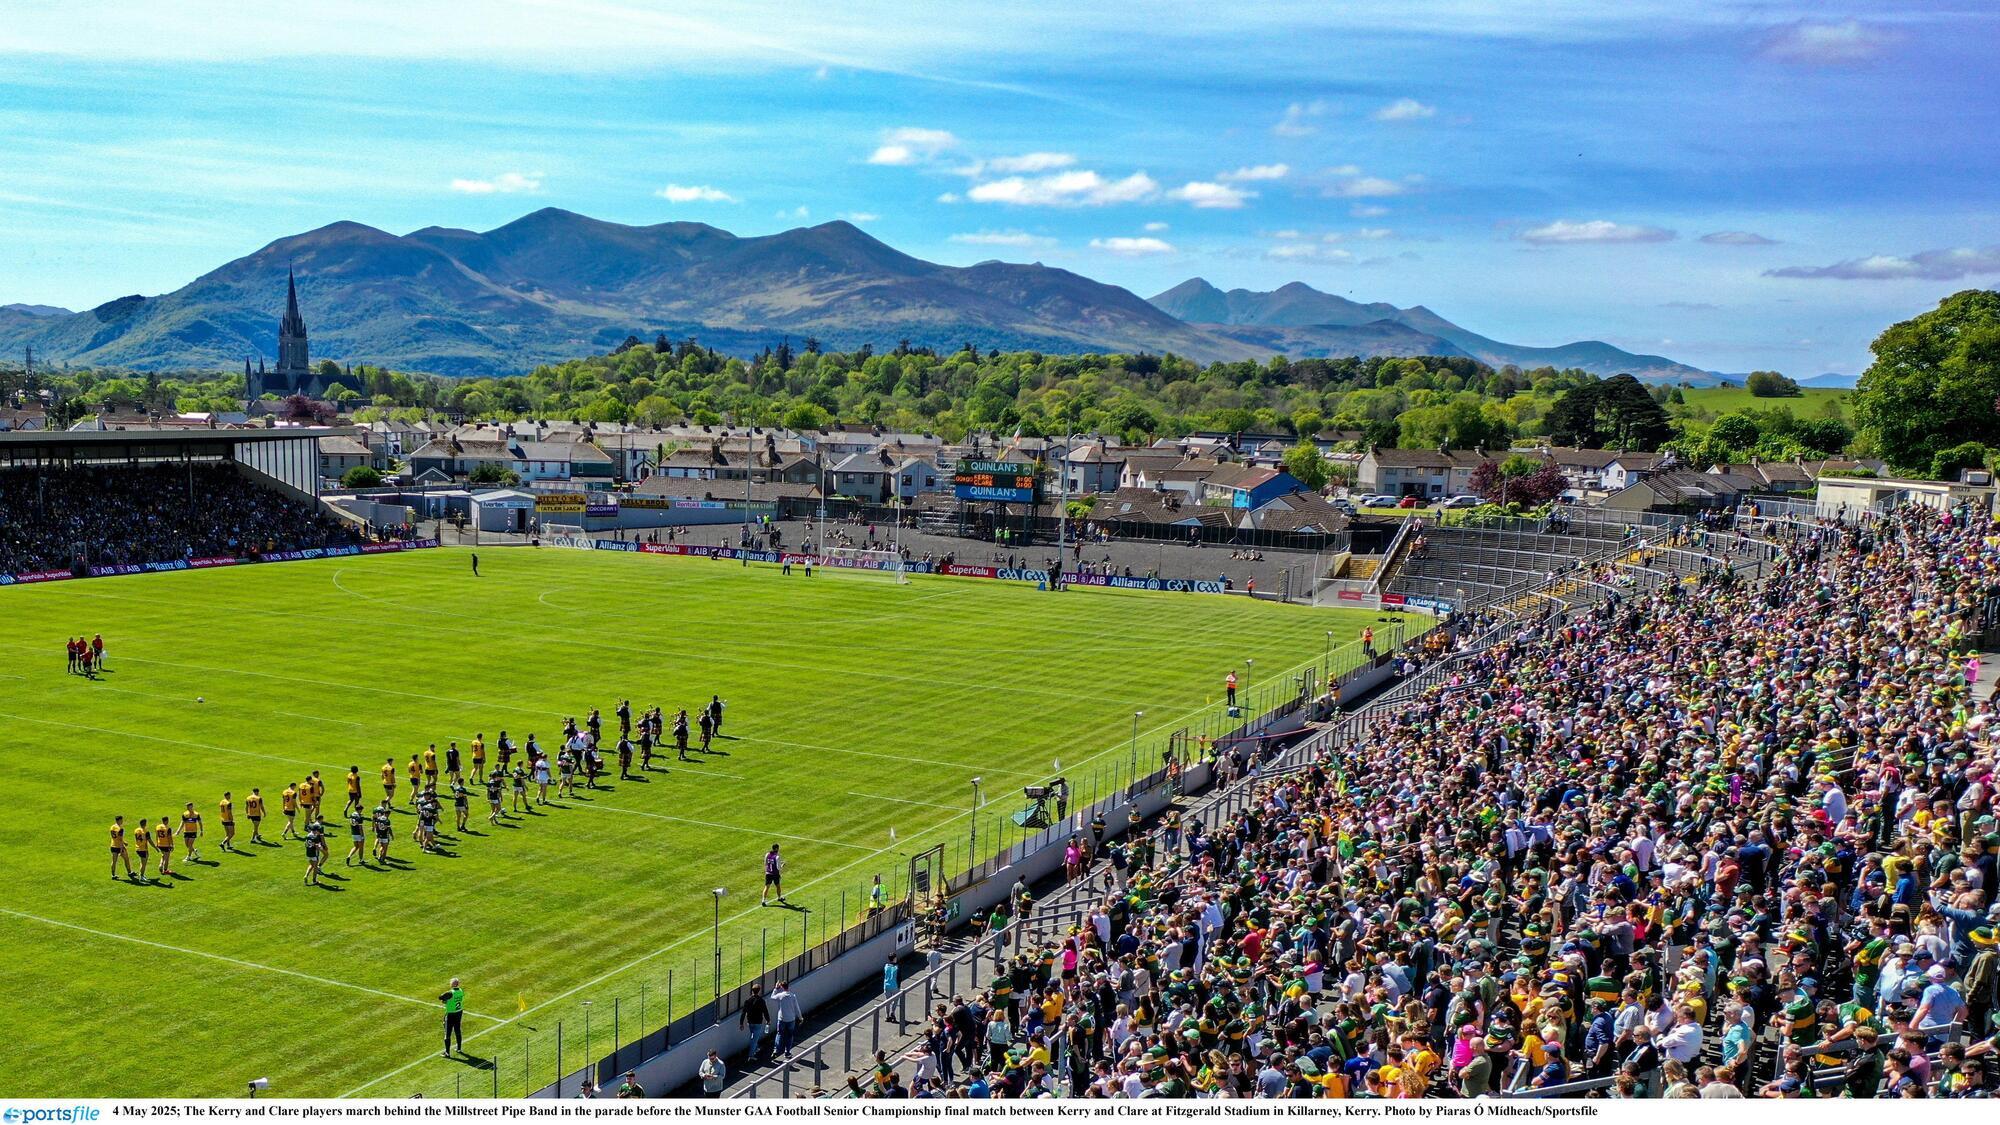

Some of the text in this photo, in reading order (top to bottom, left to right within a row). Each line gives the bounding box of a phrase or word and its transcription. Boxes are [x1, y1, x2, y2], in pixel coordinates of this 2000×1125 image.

[971, 462, 1018, 472] QUINLAN'S
[970, 487, 1017, 497] QUINLAN'S
[599, 540, 626, 551] Allianz
[645, 543, 680, 553] SuperValu
[694, 546, 708, 555] AIB
[717, 548, 731, 557] AIB
[838, 559, 853, 567] AIB
[864, 560, 879, 569] AIB
[101, 566, 115, 574] AIB
[127, 565, 141, 573] AIB
[948, 565, 989, 576] SuperValu
[1060, 573, 1077, 583] AIB
[1089, 575, 1106, 585] AIB
[1110, 577, 1145, 589] Allianz
